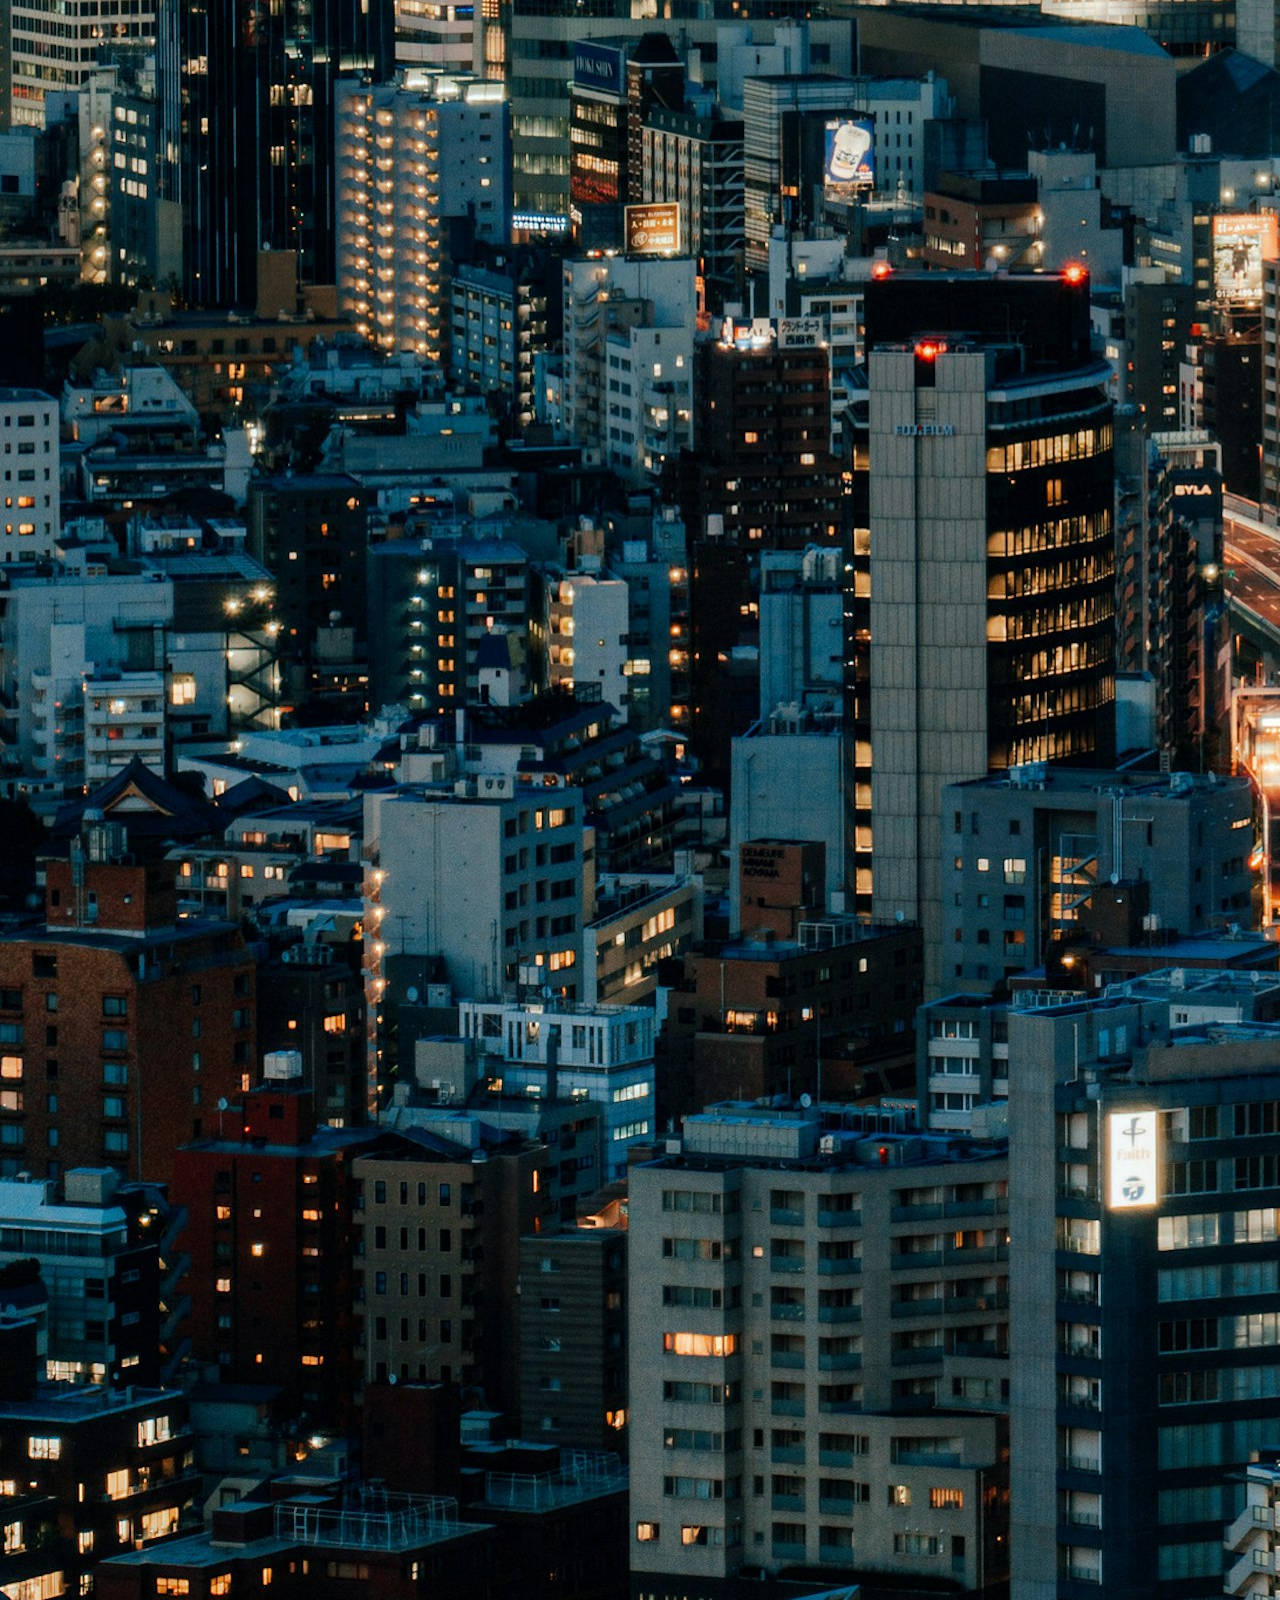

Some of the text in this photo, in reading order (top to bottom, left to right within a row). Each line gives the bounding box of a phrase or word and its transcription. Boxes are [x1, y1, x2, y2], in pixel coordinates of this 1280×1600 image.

[513, 221, 566, 231] CROSS POINT
[785, 334, 816, 345] 西麻布
[895, 423, 956, 436] FUJIFILM
[1117, 1148, 1151, 1160] Faith
